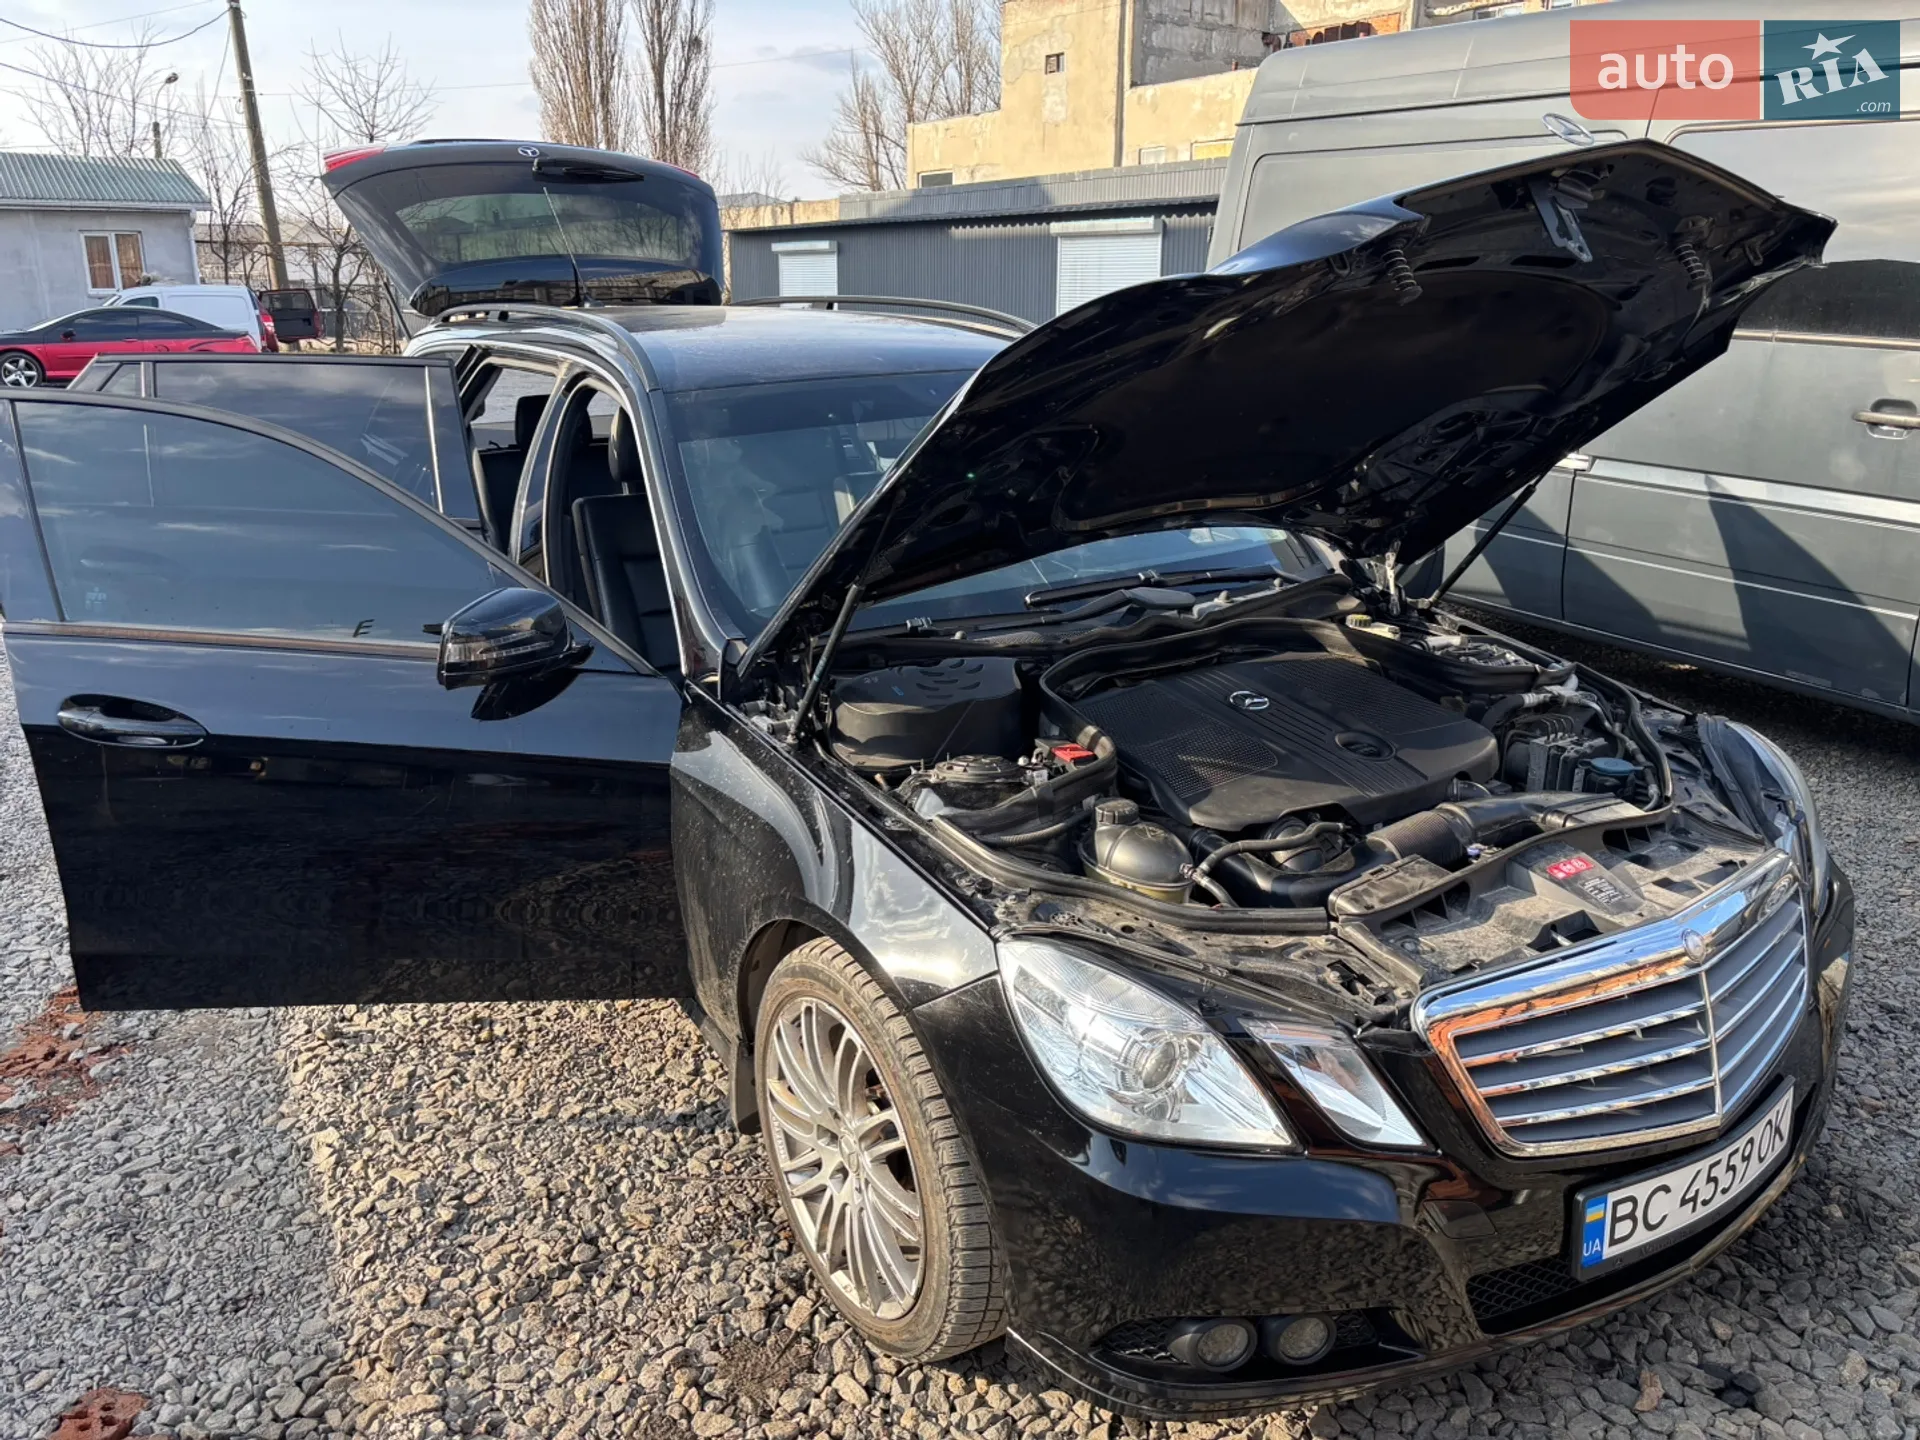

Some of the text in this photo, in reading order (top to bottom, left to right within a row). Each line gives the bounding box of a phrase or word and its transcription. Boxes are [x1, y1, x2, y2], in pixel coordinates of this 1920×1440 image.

[1609, 1184, 1672, 1247] BC
[1680, 1137, 1755, 1213] 4559
[1757, 1099, 1789, 1164] OK
[1583, 1238, 1602, 1257] UA
